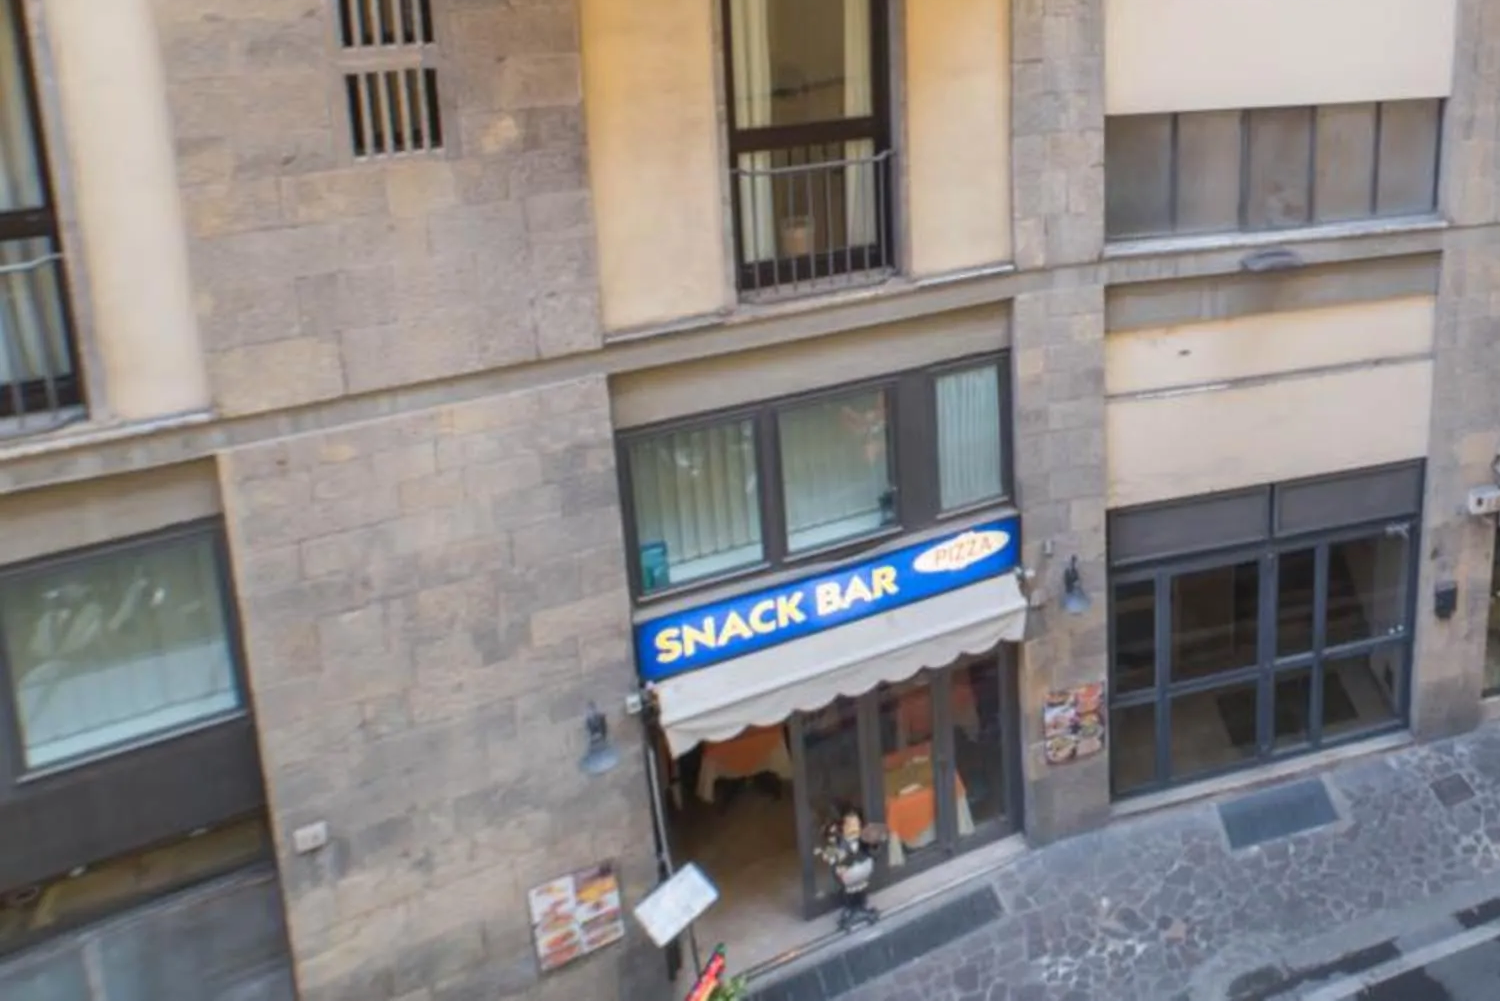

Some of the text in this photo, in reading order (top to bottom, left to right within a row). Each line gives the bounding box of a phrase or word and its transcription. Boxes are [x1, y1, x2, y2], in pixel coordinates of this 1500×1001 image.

[935, 536, 993, 563] PIZZA
[655, 565, 899, 663] SNACK BAR
